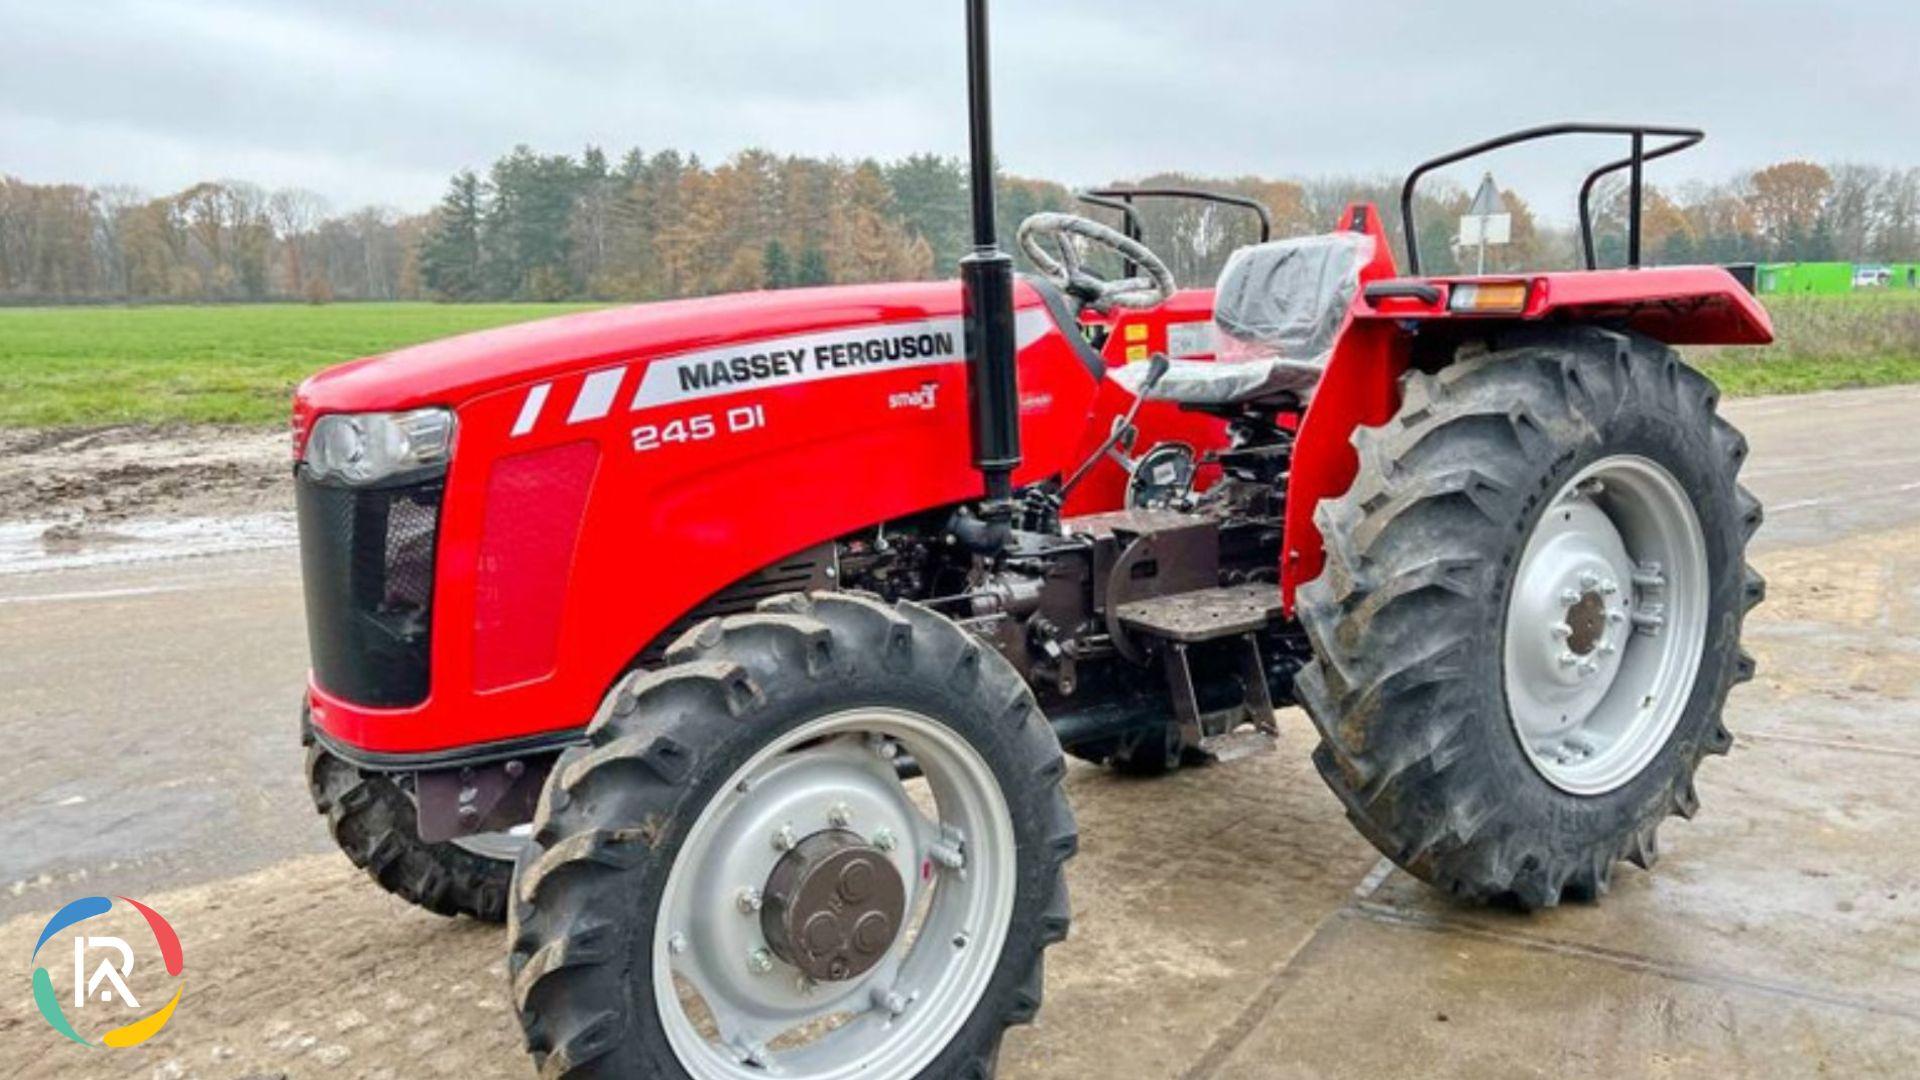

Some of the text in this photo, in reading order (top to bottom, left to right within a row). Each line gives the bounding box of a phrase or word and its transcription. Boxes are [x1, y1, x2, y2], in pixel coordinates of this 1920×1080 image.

[678, 333, 953, 391] MASSEY FERGUSON
[631, 404, 765, 450] 245 DI
